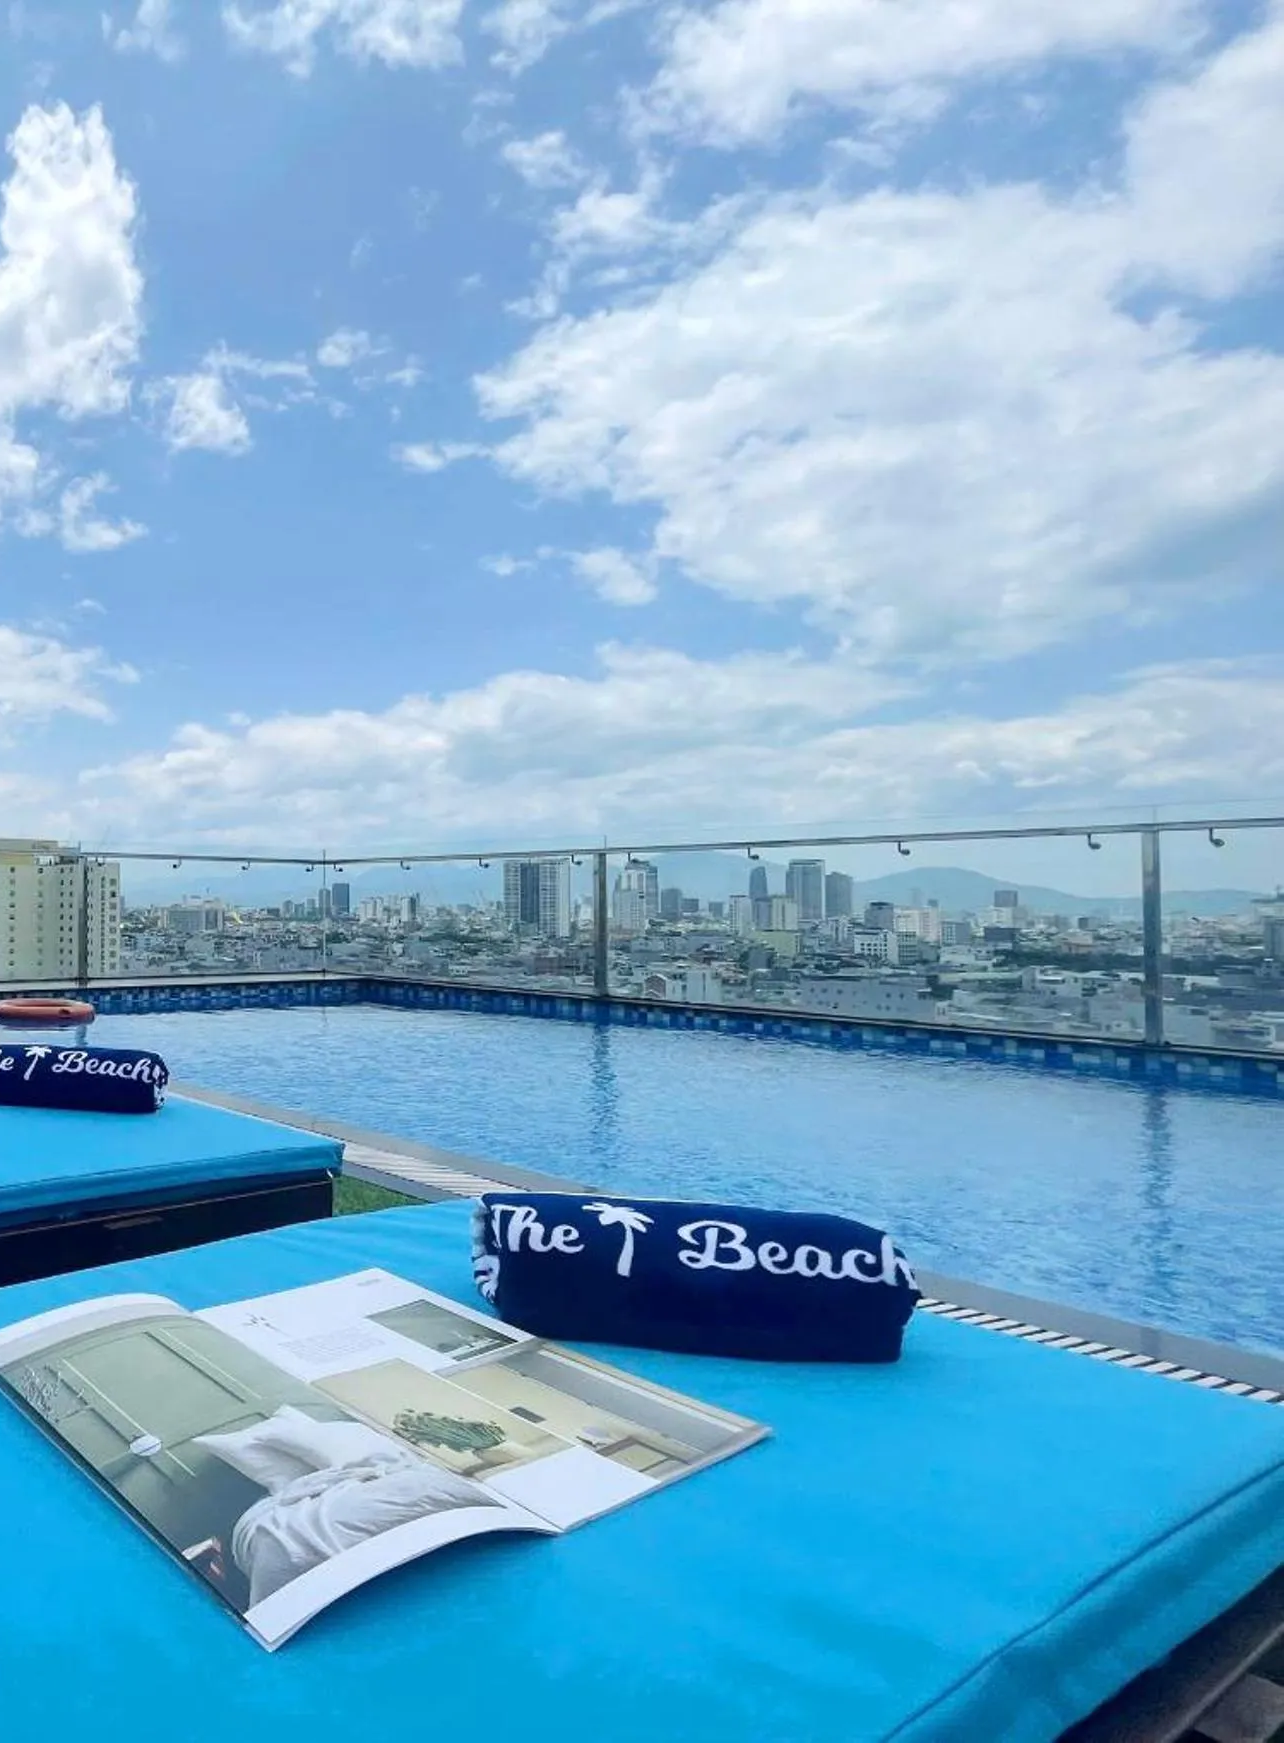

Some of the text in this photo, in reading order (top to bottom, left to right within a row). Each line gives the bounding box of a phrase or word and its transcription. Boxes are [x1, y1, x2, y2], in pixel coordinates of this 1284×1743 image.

[51, 1050, 154, 1084] Beach
[490, 1203, 918, 1290] The Beach
